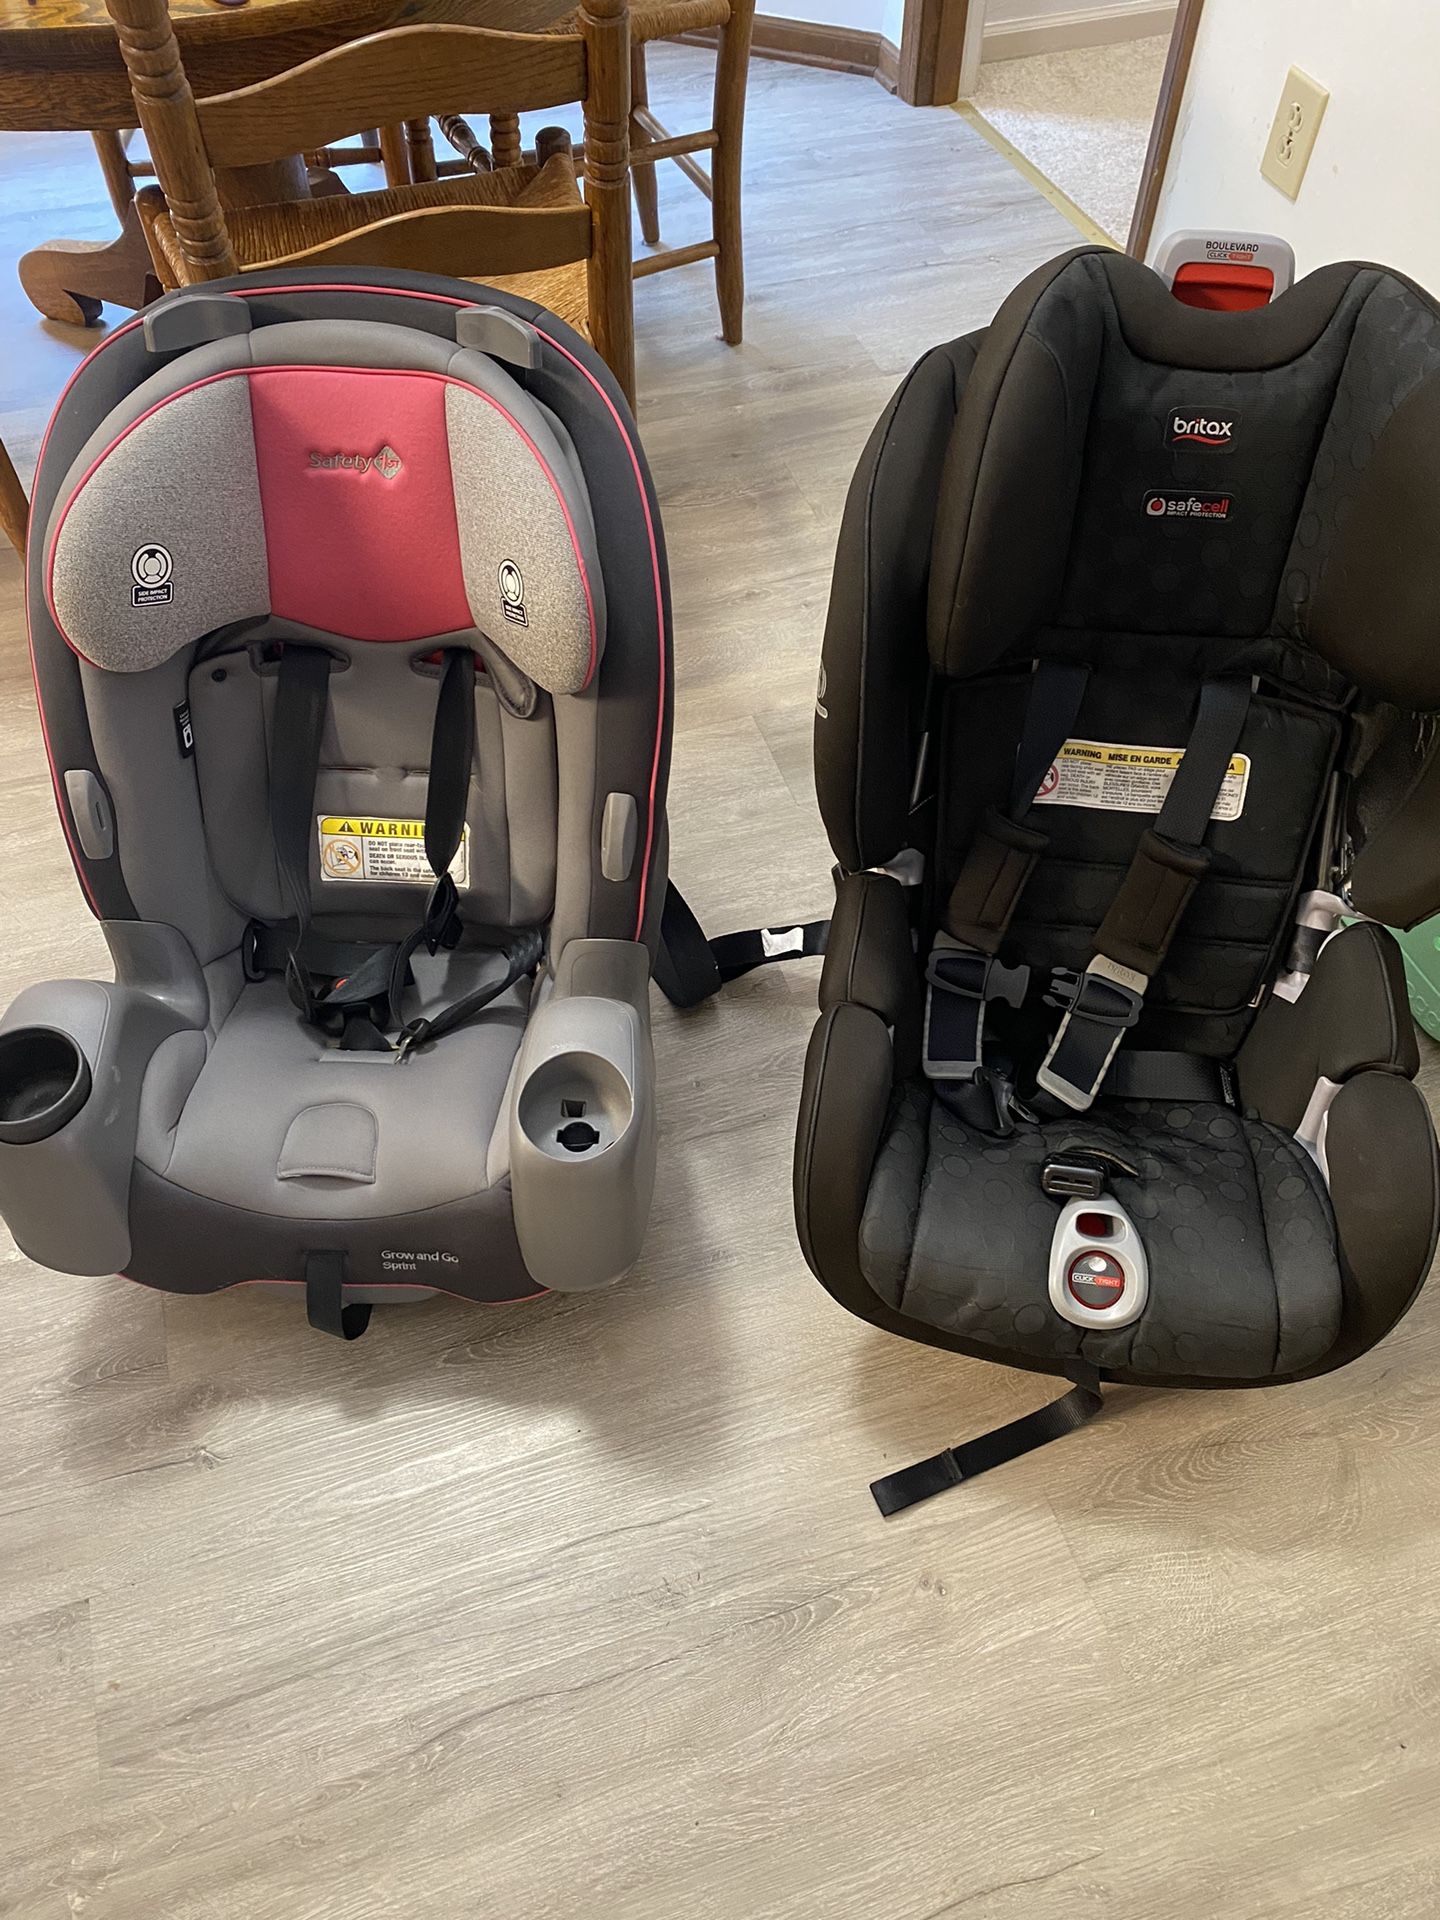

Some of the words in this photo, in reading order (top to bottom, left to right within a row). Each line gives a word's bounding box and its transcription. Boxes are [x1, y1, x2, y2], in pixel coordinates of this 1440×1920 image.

[1205, 241, 1259, 252] BOULEVARD
[1173, 417, 1233, 436] britax
[309, 450, 373, 474] Safety
[1167, 498, 1230, 513] safecell
[1189, 511, 1227, 519] PROTECTION
[1063, 747, 1102, 760] WARNING
[1107, 752, 1129, 763] MISE
[1129, 754, 1142, 764] EN
[1143, 756, 1172, 766] GARDE
[360, 822, 426, 836] WARNI
[380, 1249, 415, 1260] Grow
[416, 1251, 440, 1262] and
[441, 1252, 460, 1263] Go
[382, 1261, 417, 1271] Sprint
